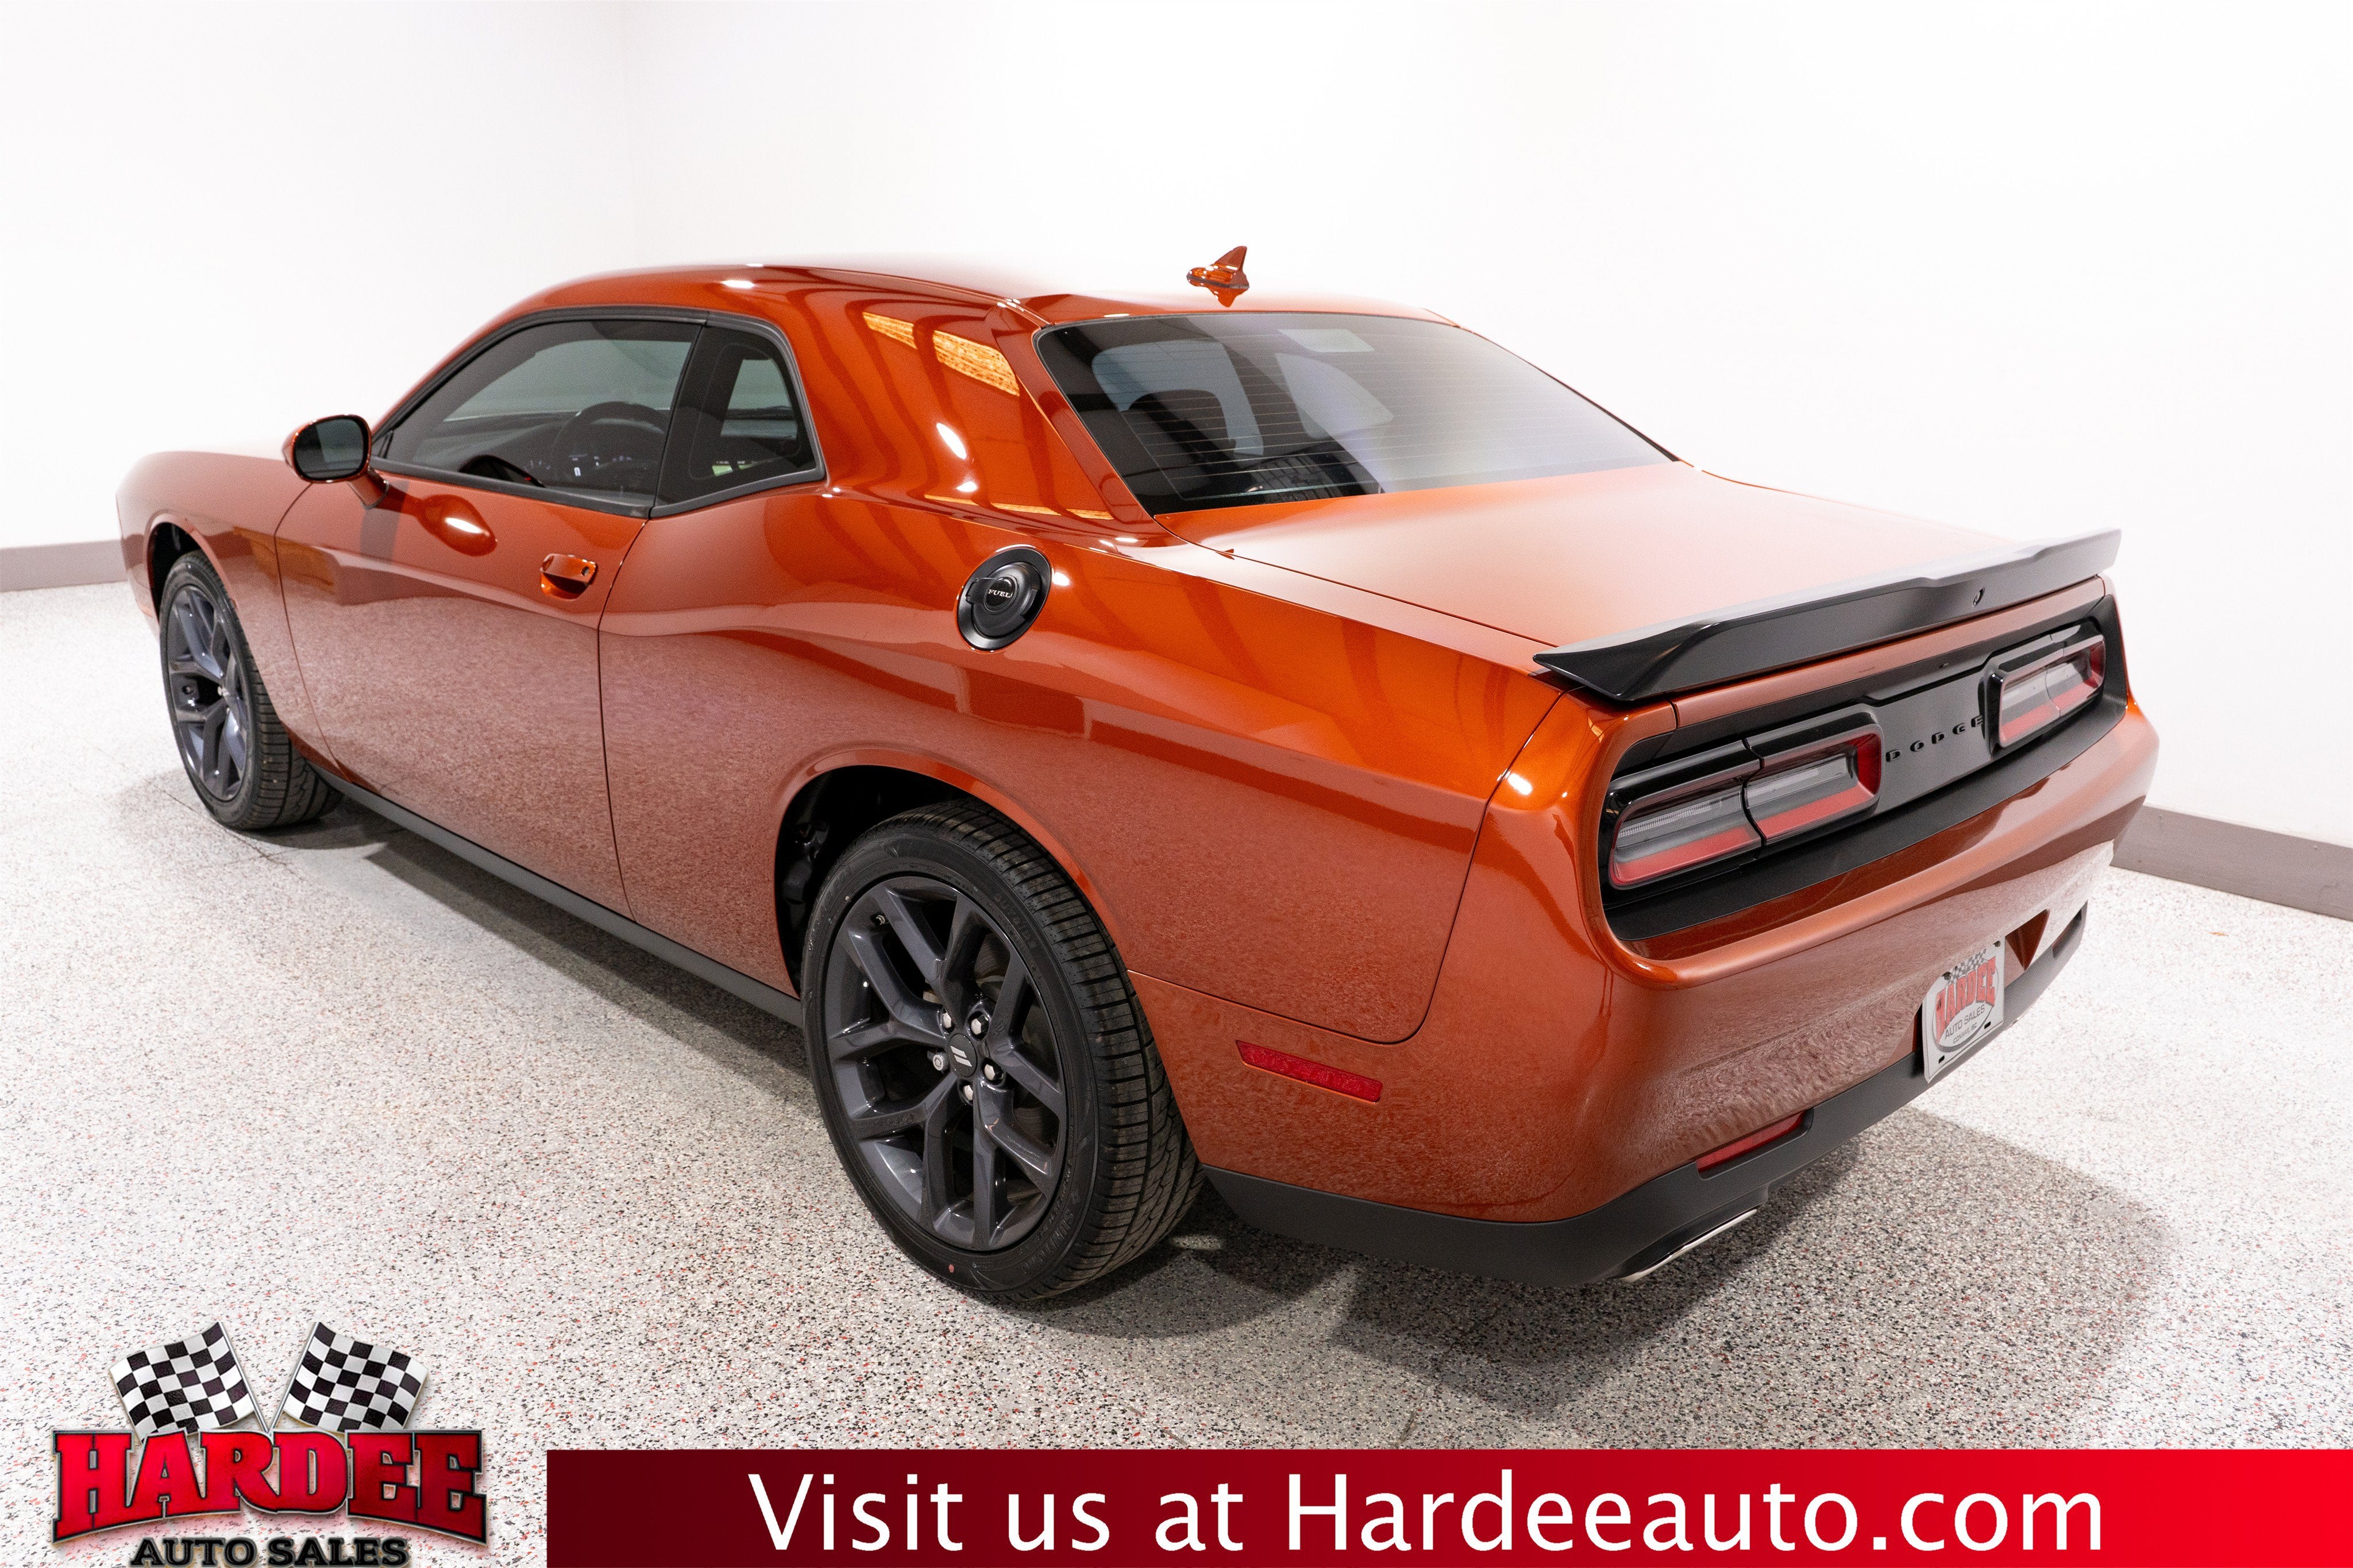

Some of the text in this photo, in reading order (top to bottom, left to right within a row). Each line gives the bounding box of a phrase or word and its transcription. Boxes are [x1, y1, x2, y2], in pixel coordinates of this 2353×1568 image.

[988, 589, 1012, 598] FUEL
[1885, 715, 1983, 762] DODGE
[1936, 956, 1996, 1044] HARDEE
[1945, 1005, 1985, 1040] AUTO SALES
[1972, 1022, 1977, 1032] SC
